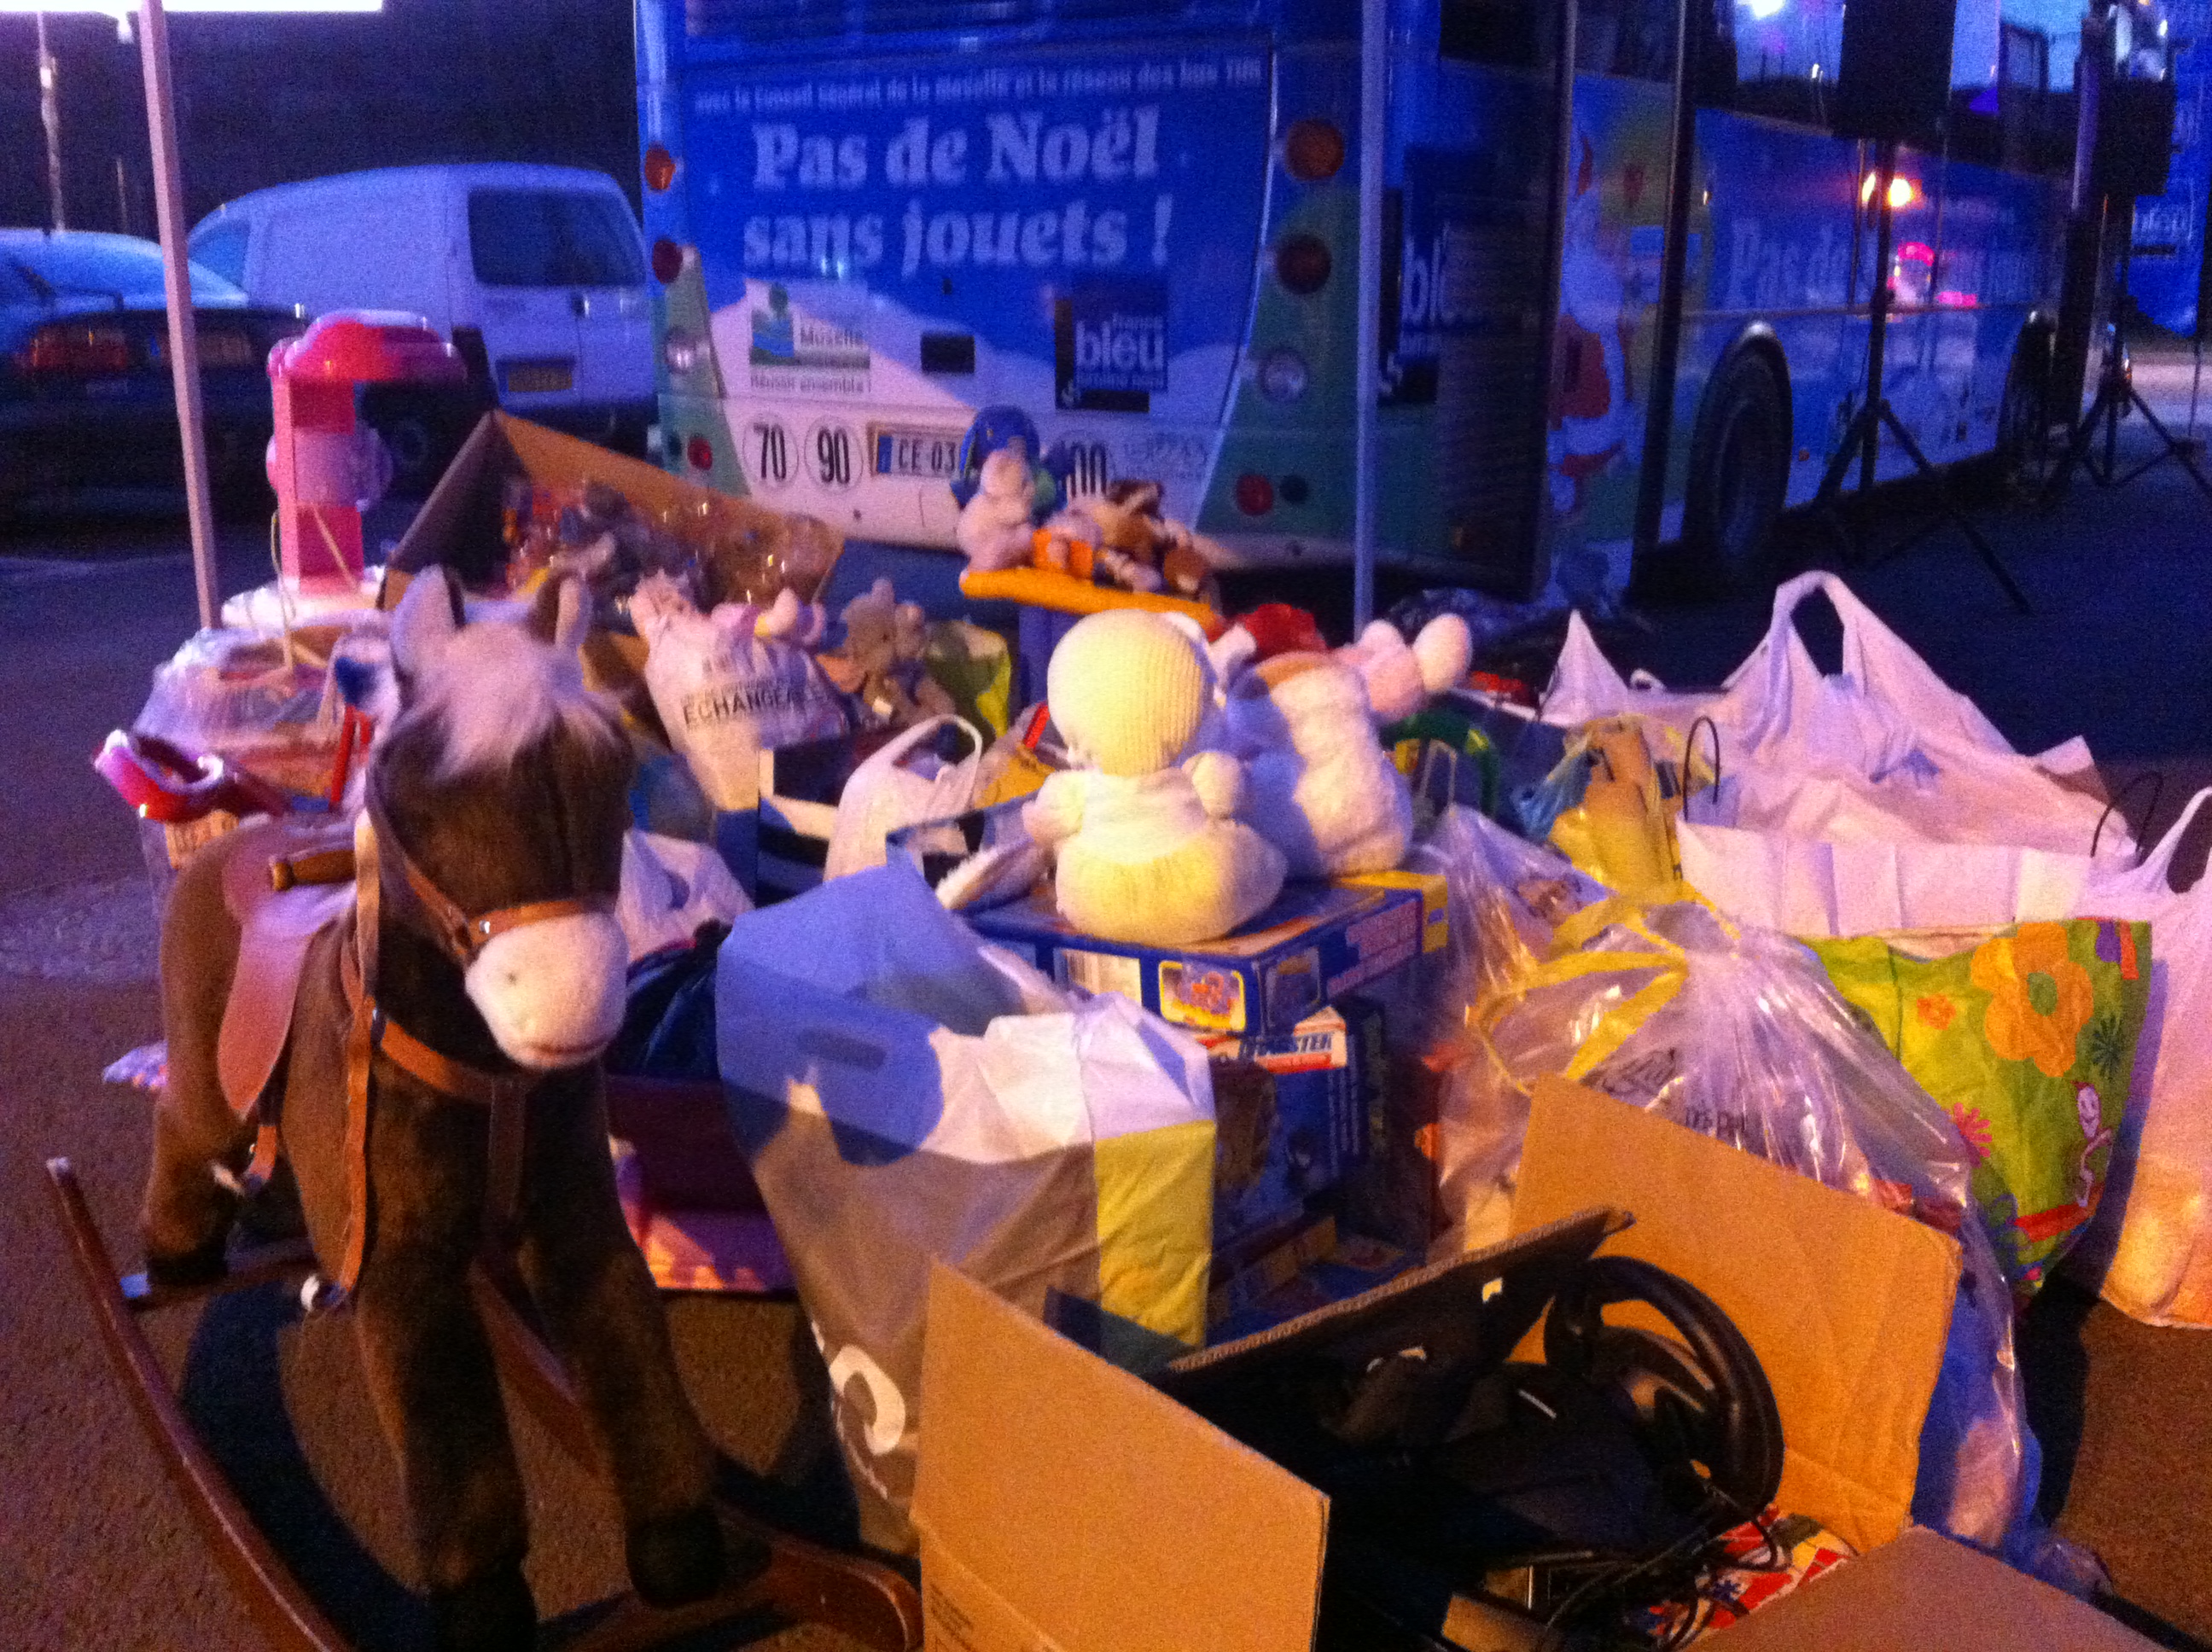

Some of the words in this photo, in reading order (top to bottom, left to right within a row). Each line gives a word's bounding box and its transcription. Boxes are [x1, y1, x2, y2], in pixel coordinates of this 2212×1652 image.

[751, 120, 868, 191] Pas
[884, 115, 968, 187] de
[985, 104, 1161, 182] Noël
[742, 212, 884, 270] sans
[899, 197, 1128, 281] jouets
[1152, 192, 1173, 266] !
[1075, 320, 1165, 371] bleu
[753, 423, 788, 482] 70
[816, 428, 851, 486] 90
[1063, 440, 1108, 498] 00
